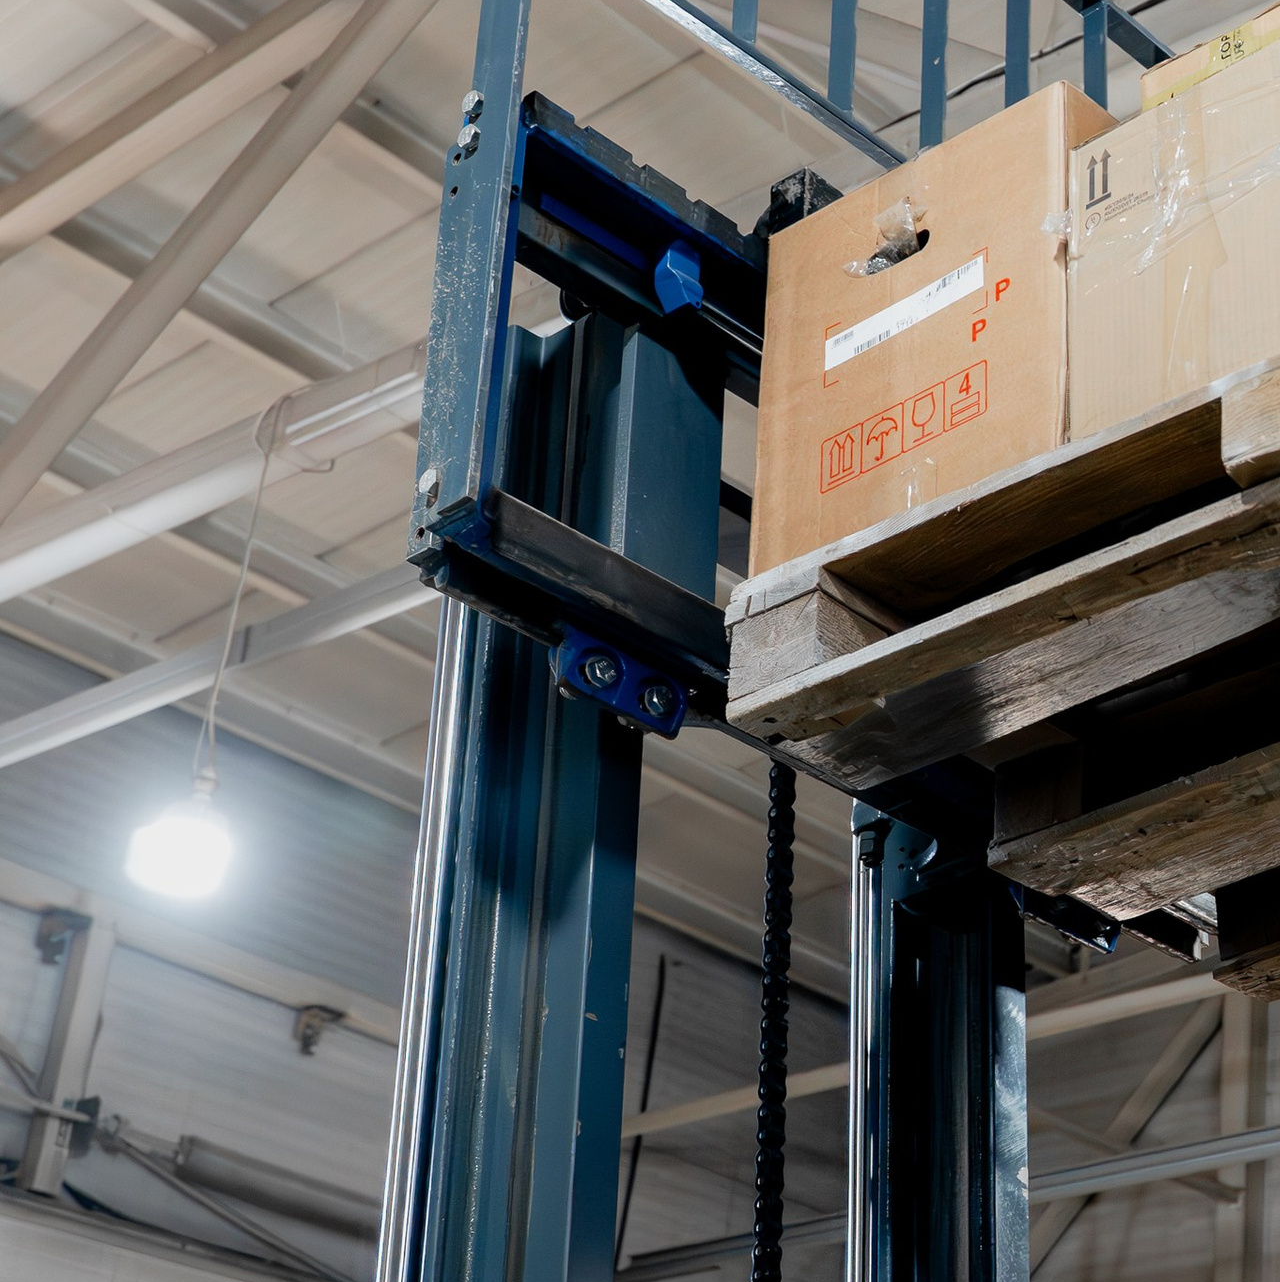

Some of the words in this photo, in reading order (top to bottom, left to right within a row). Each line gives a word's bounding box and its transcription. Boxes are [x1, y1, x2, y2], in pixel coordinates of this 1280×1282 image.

[994, 277, 1011, 303] P
[970, 318, 987, 343] P
[958, 372, 972, 396] 4
